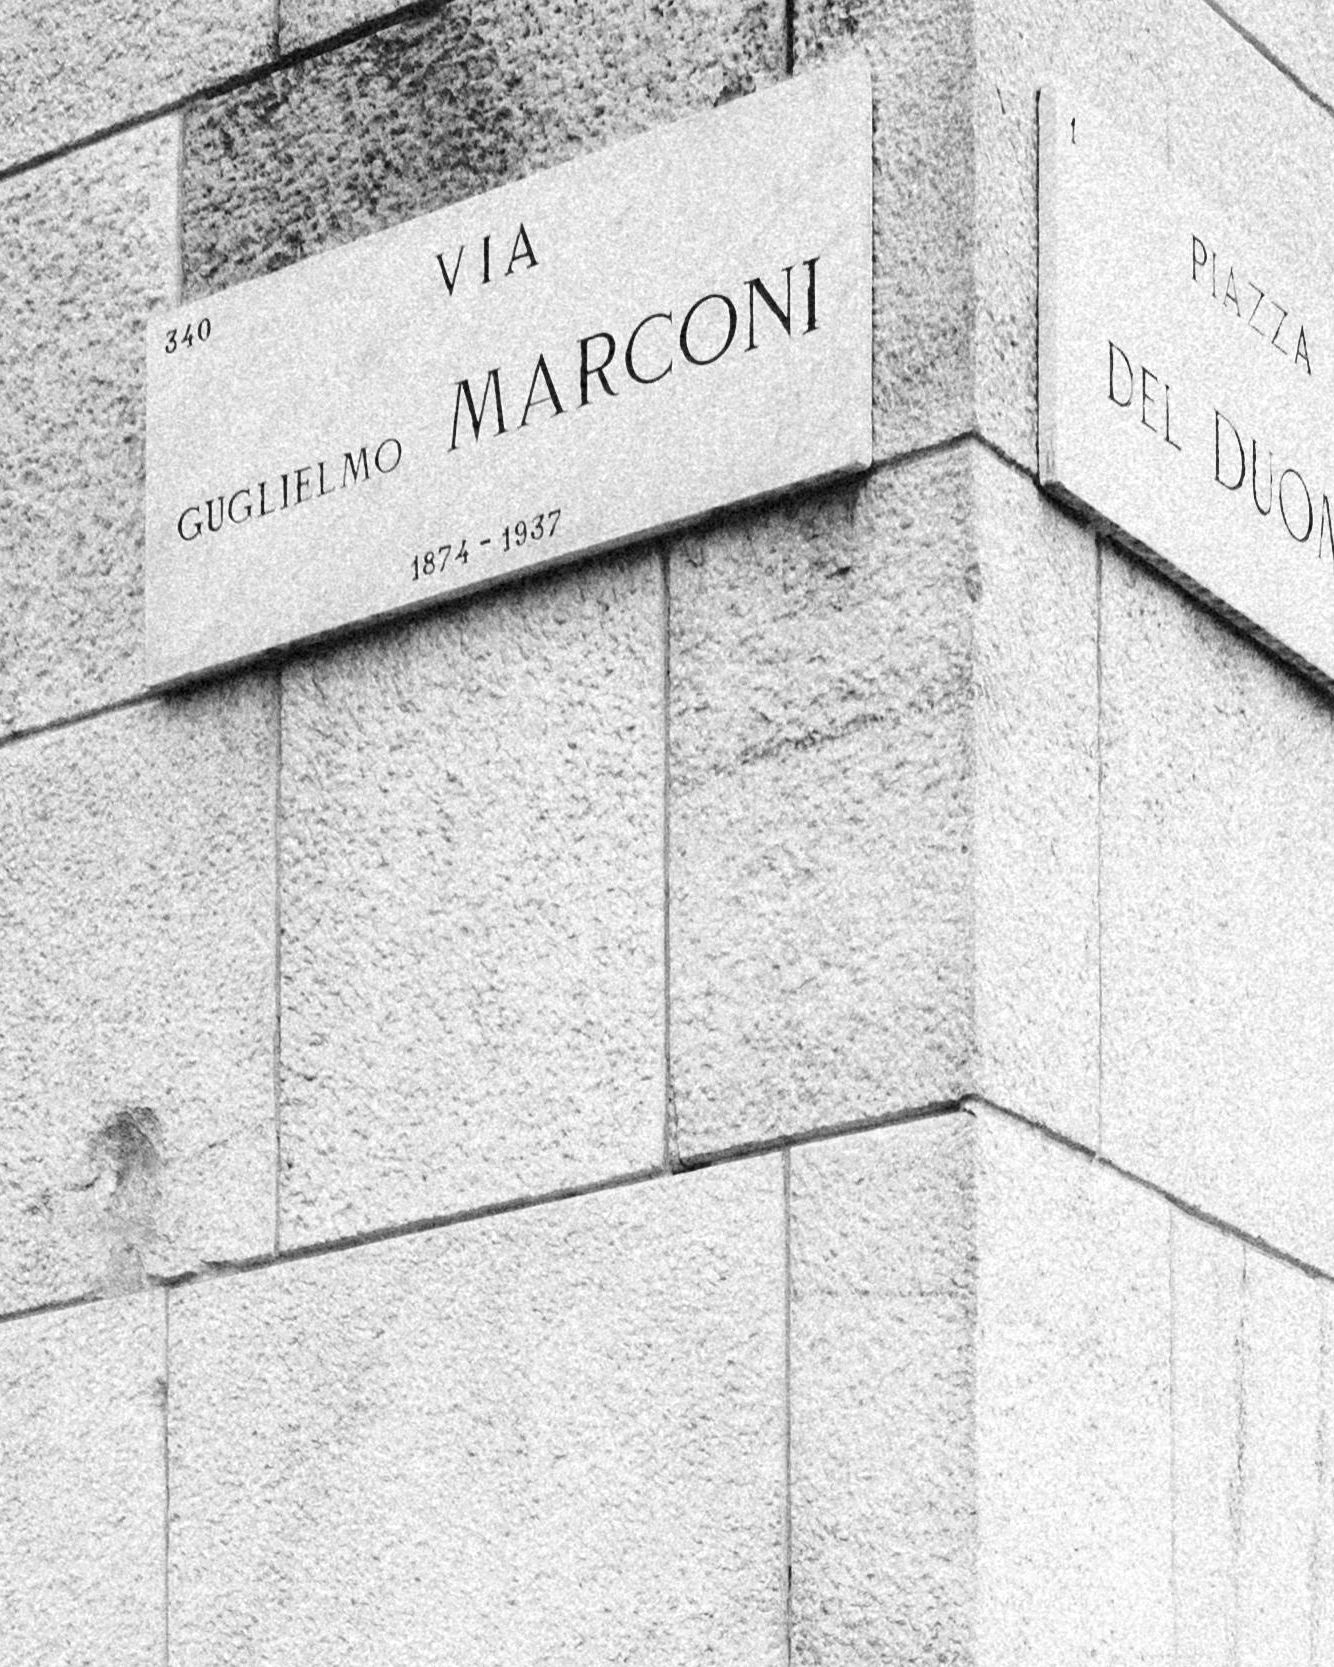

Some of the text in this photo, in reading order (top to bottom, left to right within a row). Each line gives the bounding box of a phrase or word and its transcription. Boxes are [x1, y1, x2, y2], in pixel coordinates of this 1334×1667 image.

[435, 223, 540, 296] VIA
[1191, 234, 1312, 376] PIAZZA
[164, 317, 212, 354] 340
[177, 257, 821, 542] GUGLIELMO MARCONI
[1108, 340, 1182, 451] DEL
[412, 539, 469, 581] 1874
[502, 508, 562, 552] 1937
